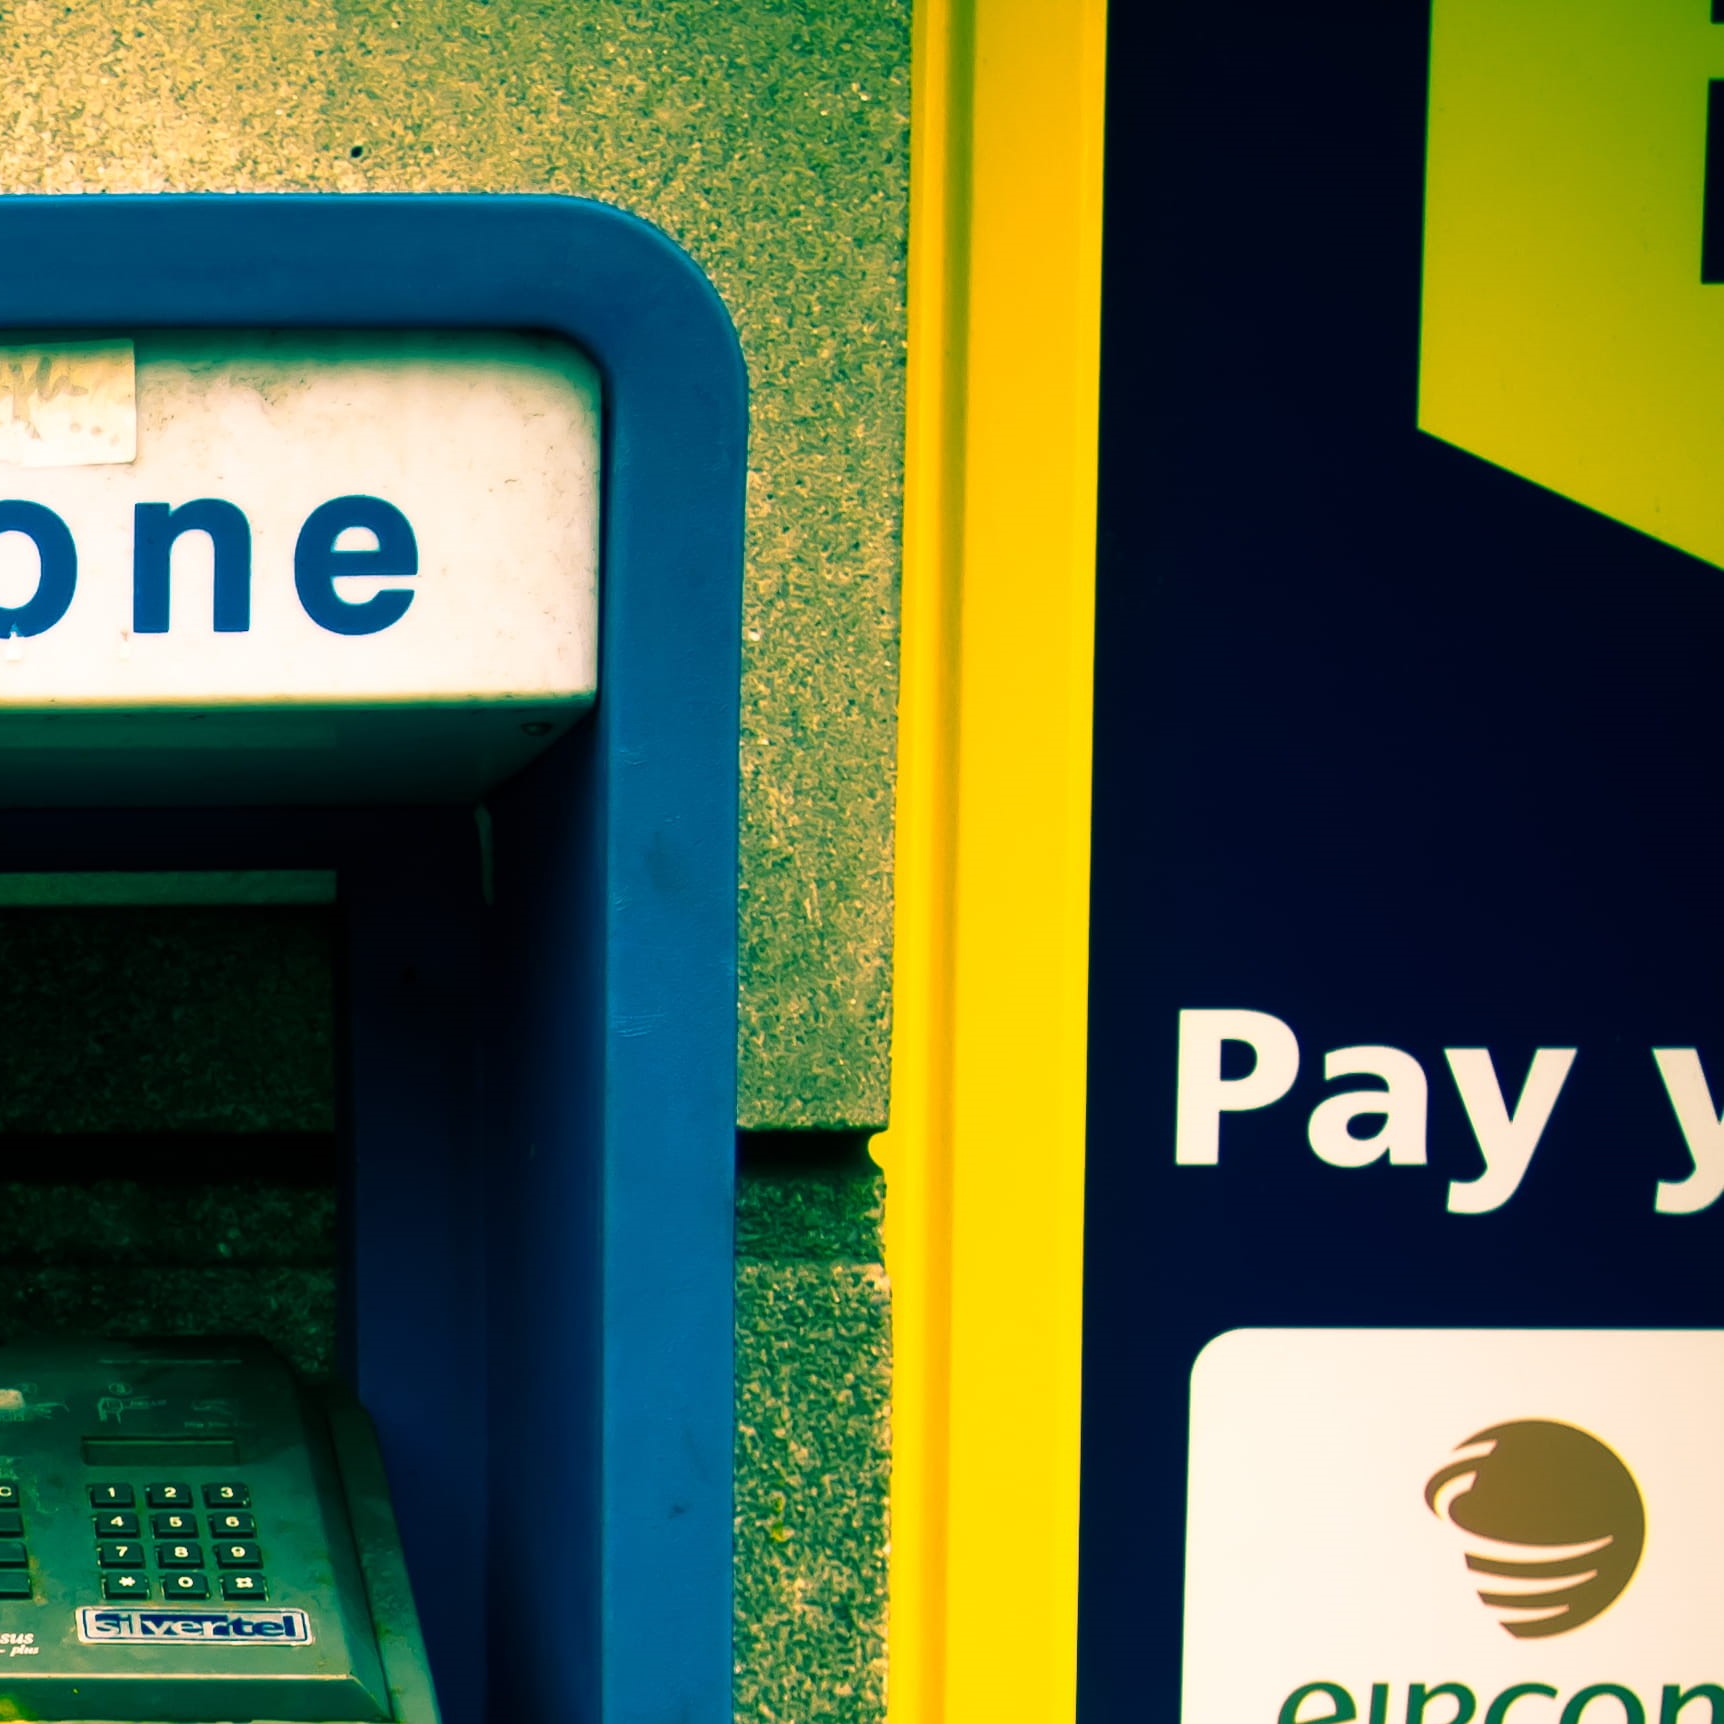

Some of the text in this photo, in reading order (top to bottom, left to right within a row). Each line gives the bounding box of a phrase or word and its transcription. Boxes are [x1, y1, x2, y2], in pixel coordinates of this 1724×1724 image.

[1175, 1009, 1577, 1214] Pay
[108, 1486, 234, 1498] 1 2 3
[110, 1515, 240, 1528] 4 5 6
[116, 1545, 246, 1558] 7 8 9
[94, 1613, 297, 1638] silvertel
[9, 1643, 40, 1657] plus
